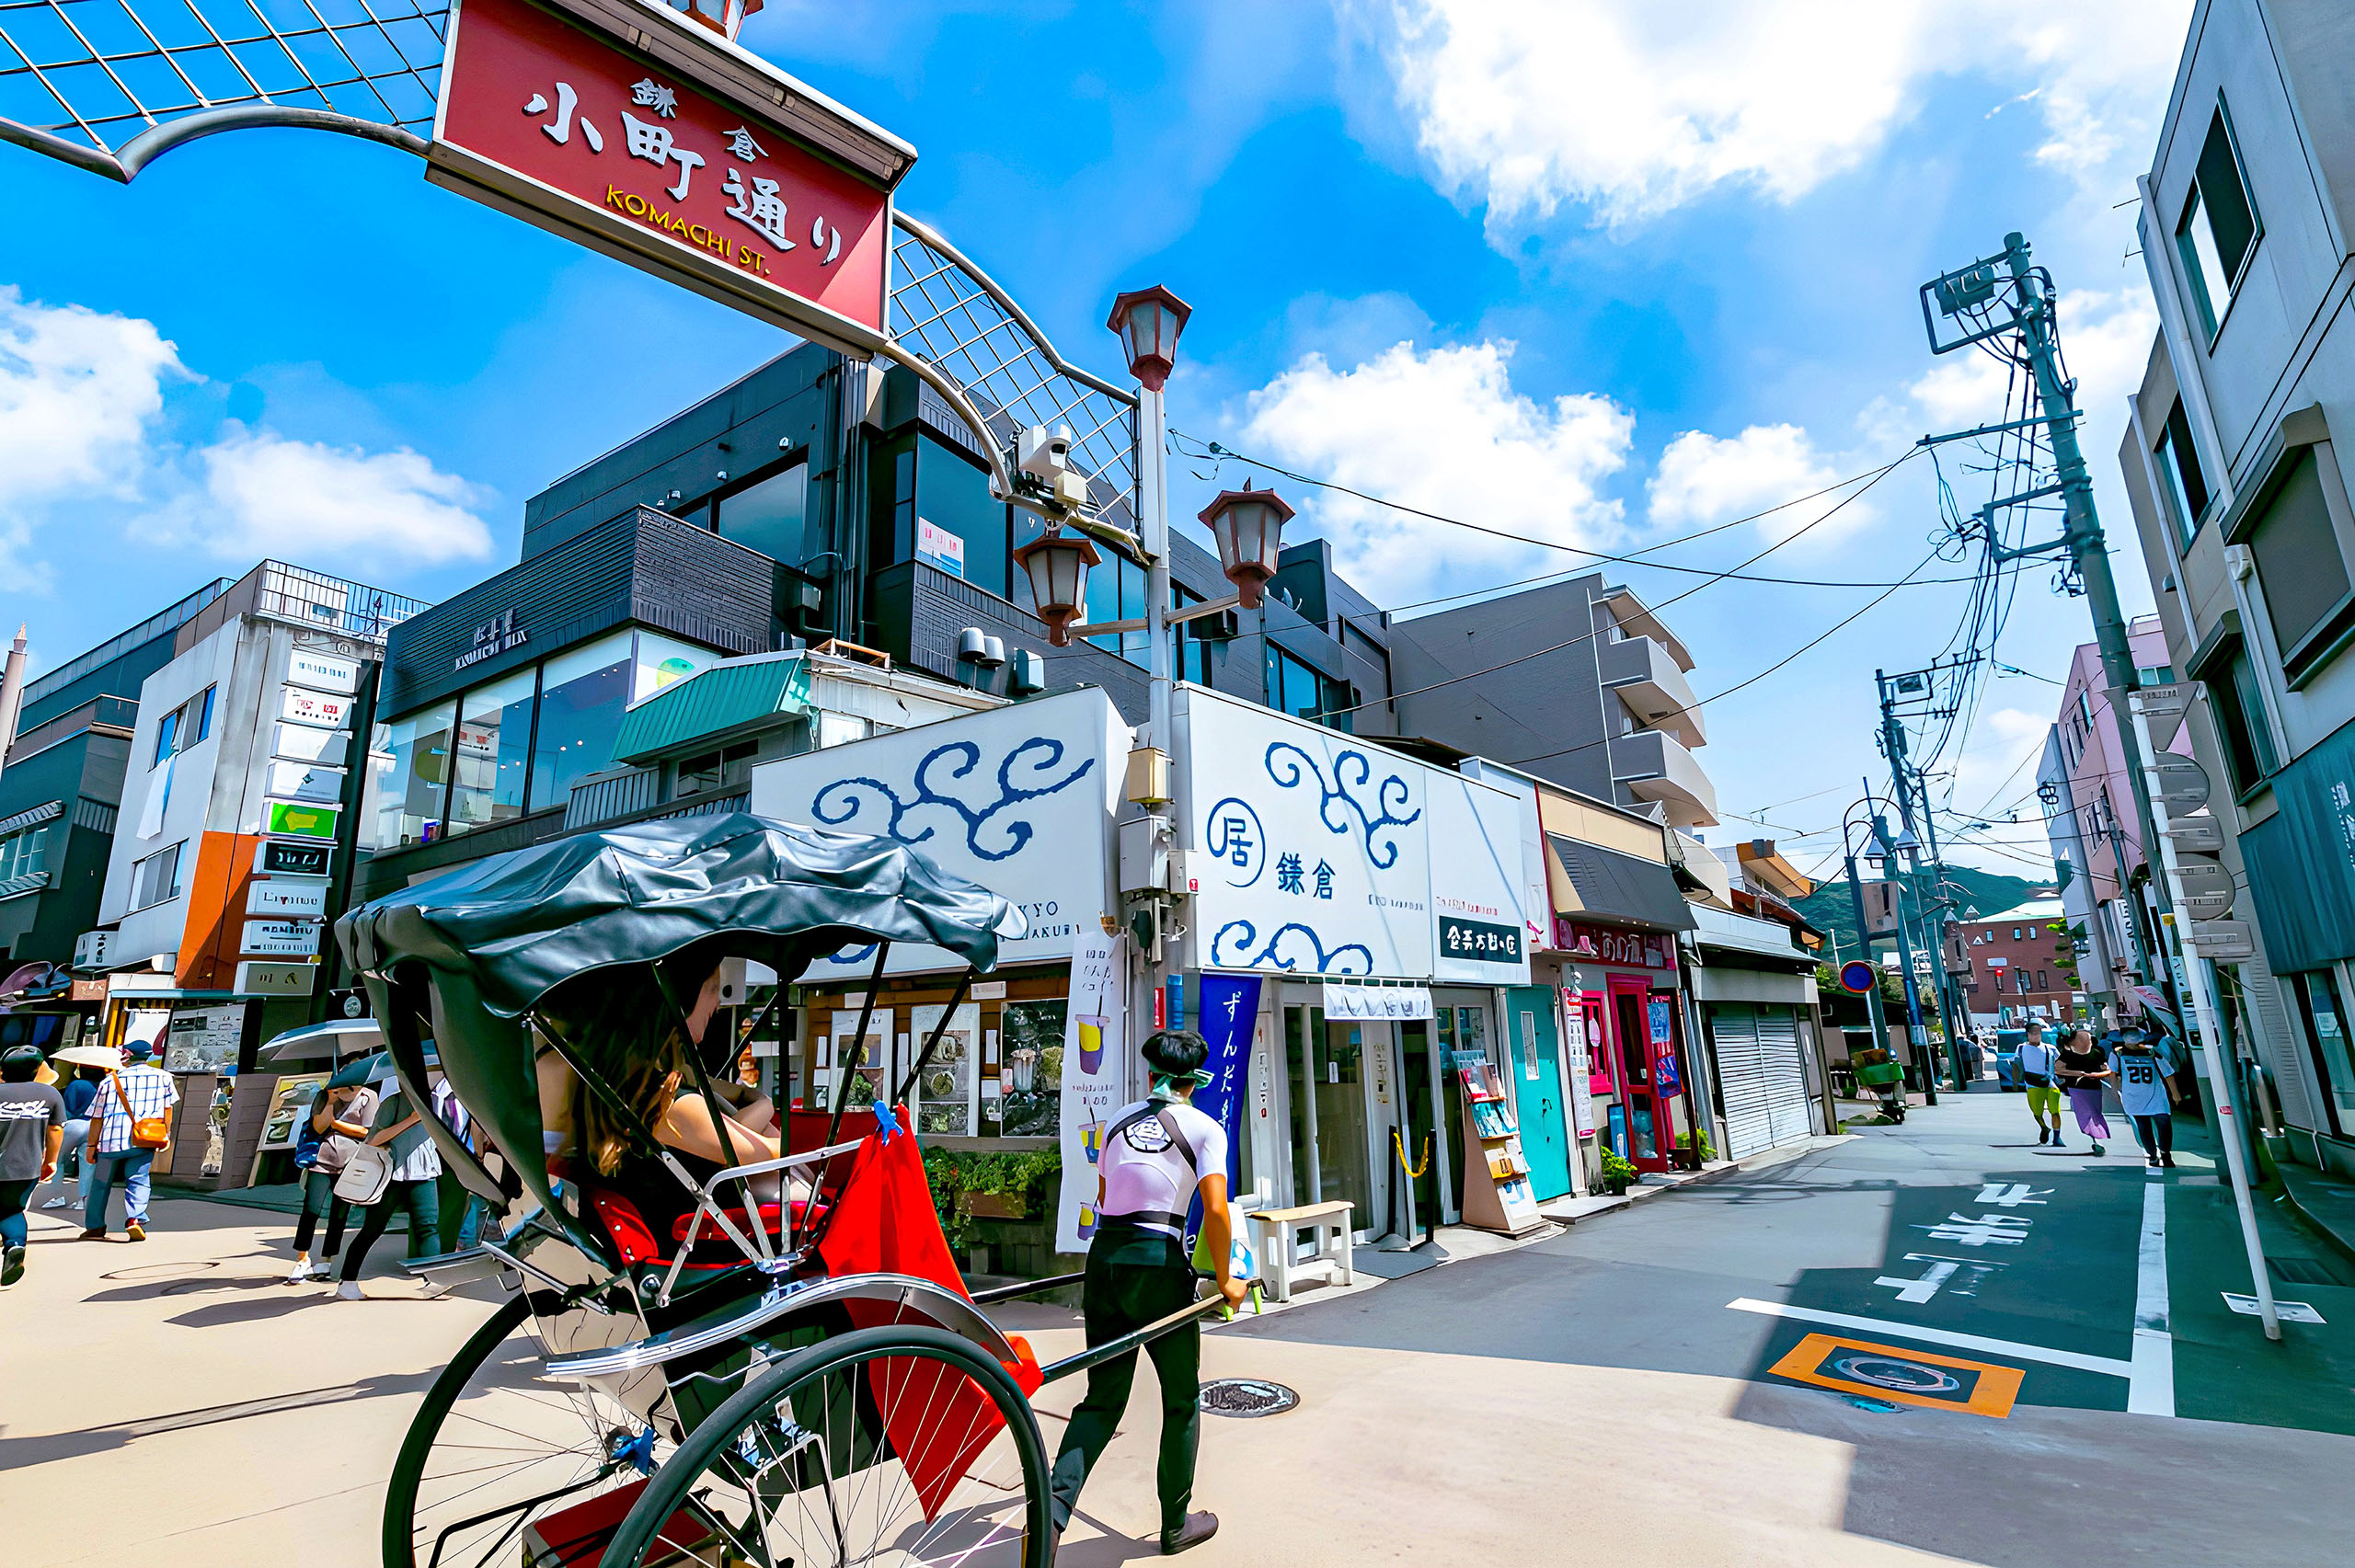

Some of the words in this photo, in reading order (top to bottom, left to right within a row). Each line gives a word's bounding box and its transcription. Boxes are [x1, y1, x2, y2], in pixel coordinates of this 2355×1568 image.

[630, 77, 770, 164] 鎌倉
[523, 81, 842, 267] 小町通り
[605, 184, 732, 259] KOMACHI
[739, 249, 772, 276] ST.
[1276, 852, 1337, 900] 鎌倉
[2126, 1066, 2153, 1084] 28
